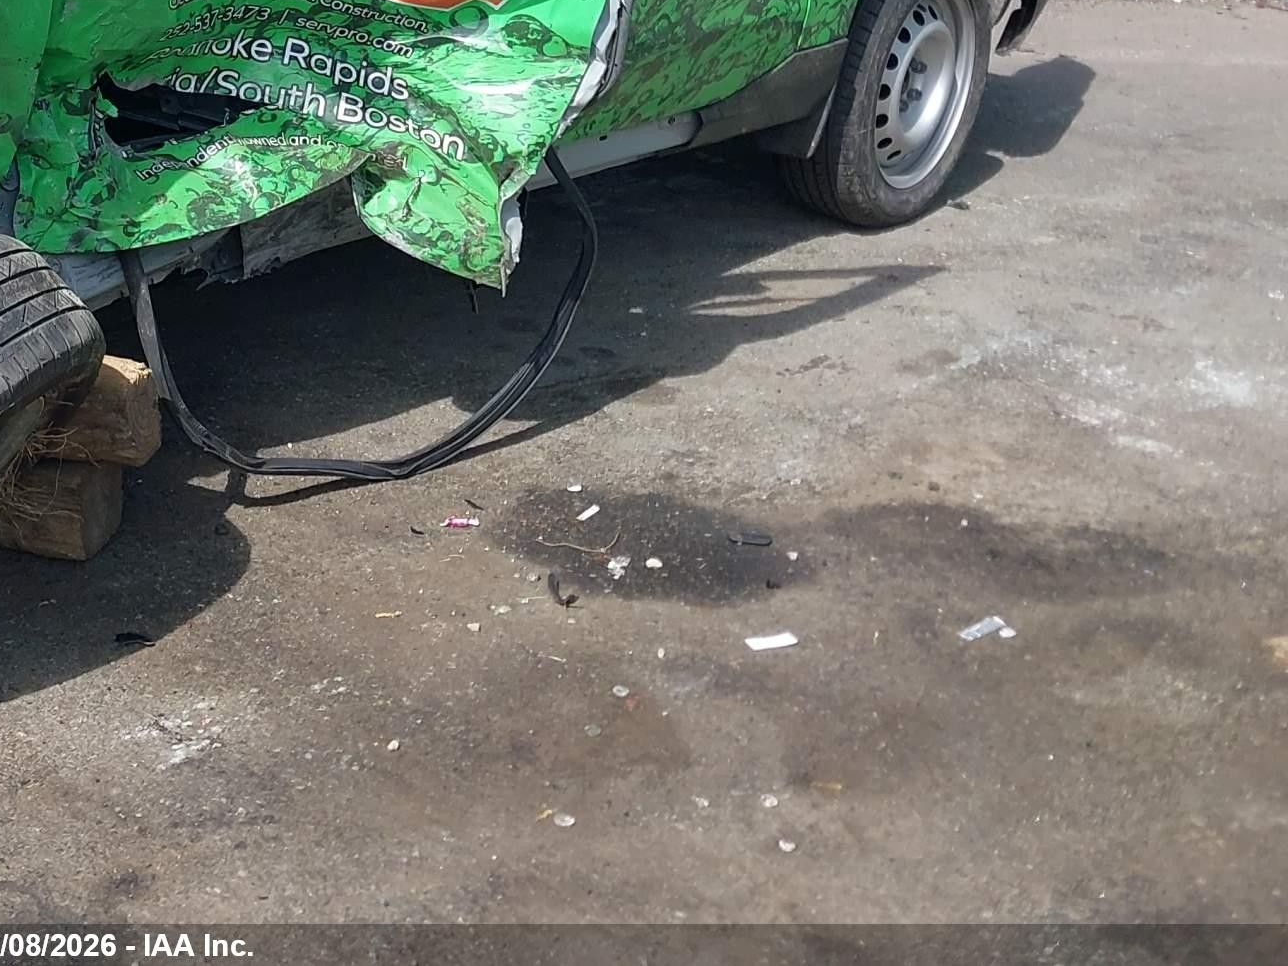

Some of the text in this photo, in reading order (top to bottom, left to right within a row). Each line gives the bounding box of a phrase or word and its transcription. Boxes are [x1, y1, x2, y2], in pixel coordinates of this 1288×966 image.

[159, 5, 271, 42] 252-537-3473
[296, 16, 413, 58] servpro.com
[282, 37, 409, 100] Rapids
[289, 135, 322, 147] and
[337, 92, 464, 161] Boston
